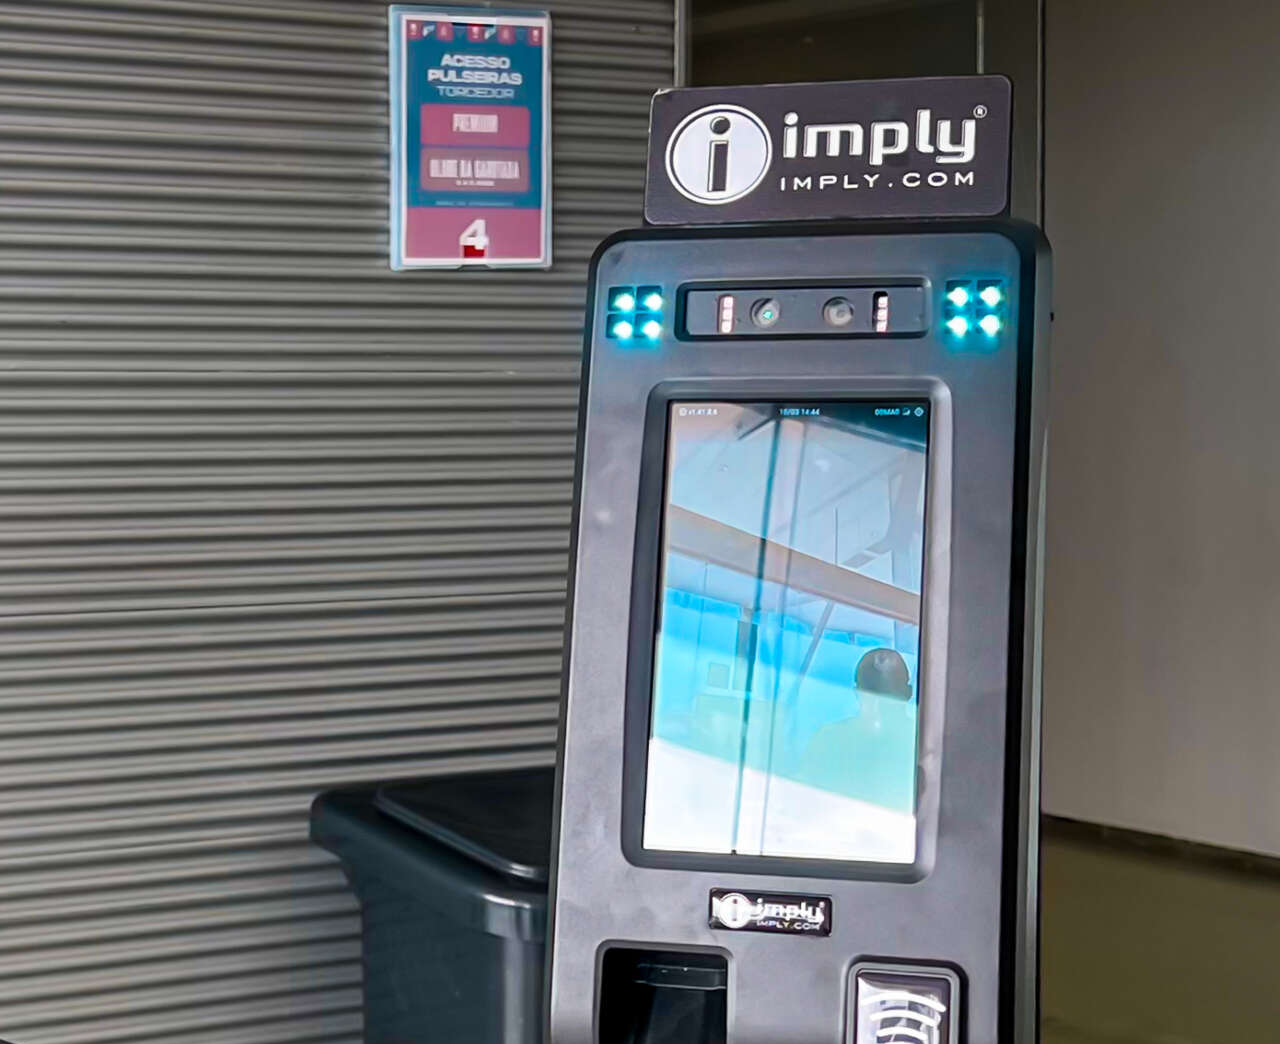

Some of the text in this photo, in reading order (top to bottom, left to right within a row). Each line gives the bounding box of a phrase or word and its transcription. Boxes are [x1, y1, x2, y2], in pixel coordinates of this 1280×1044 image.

[440, 53, 511, 69] ACESSO
[436, 86, 516, 99] TORCEDOR
[780, 171, 976, 191] IMPLY.COM
[459, 219, 489, 251] 4
